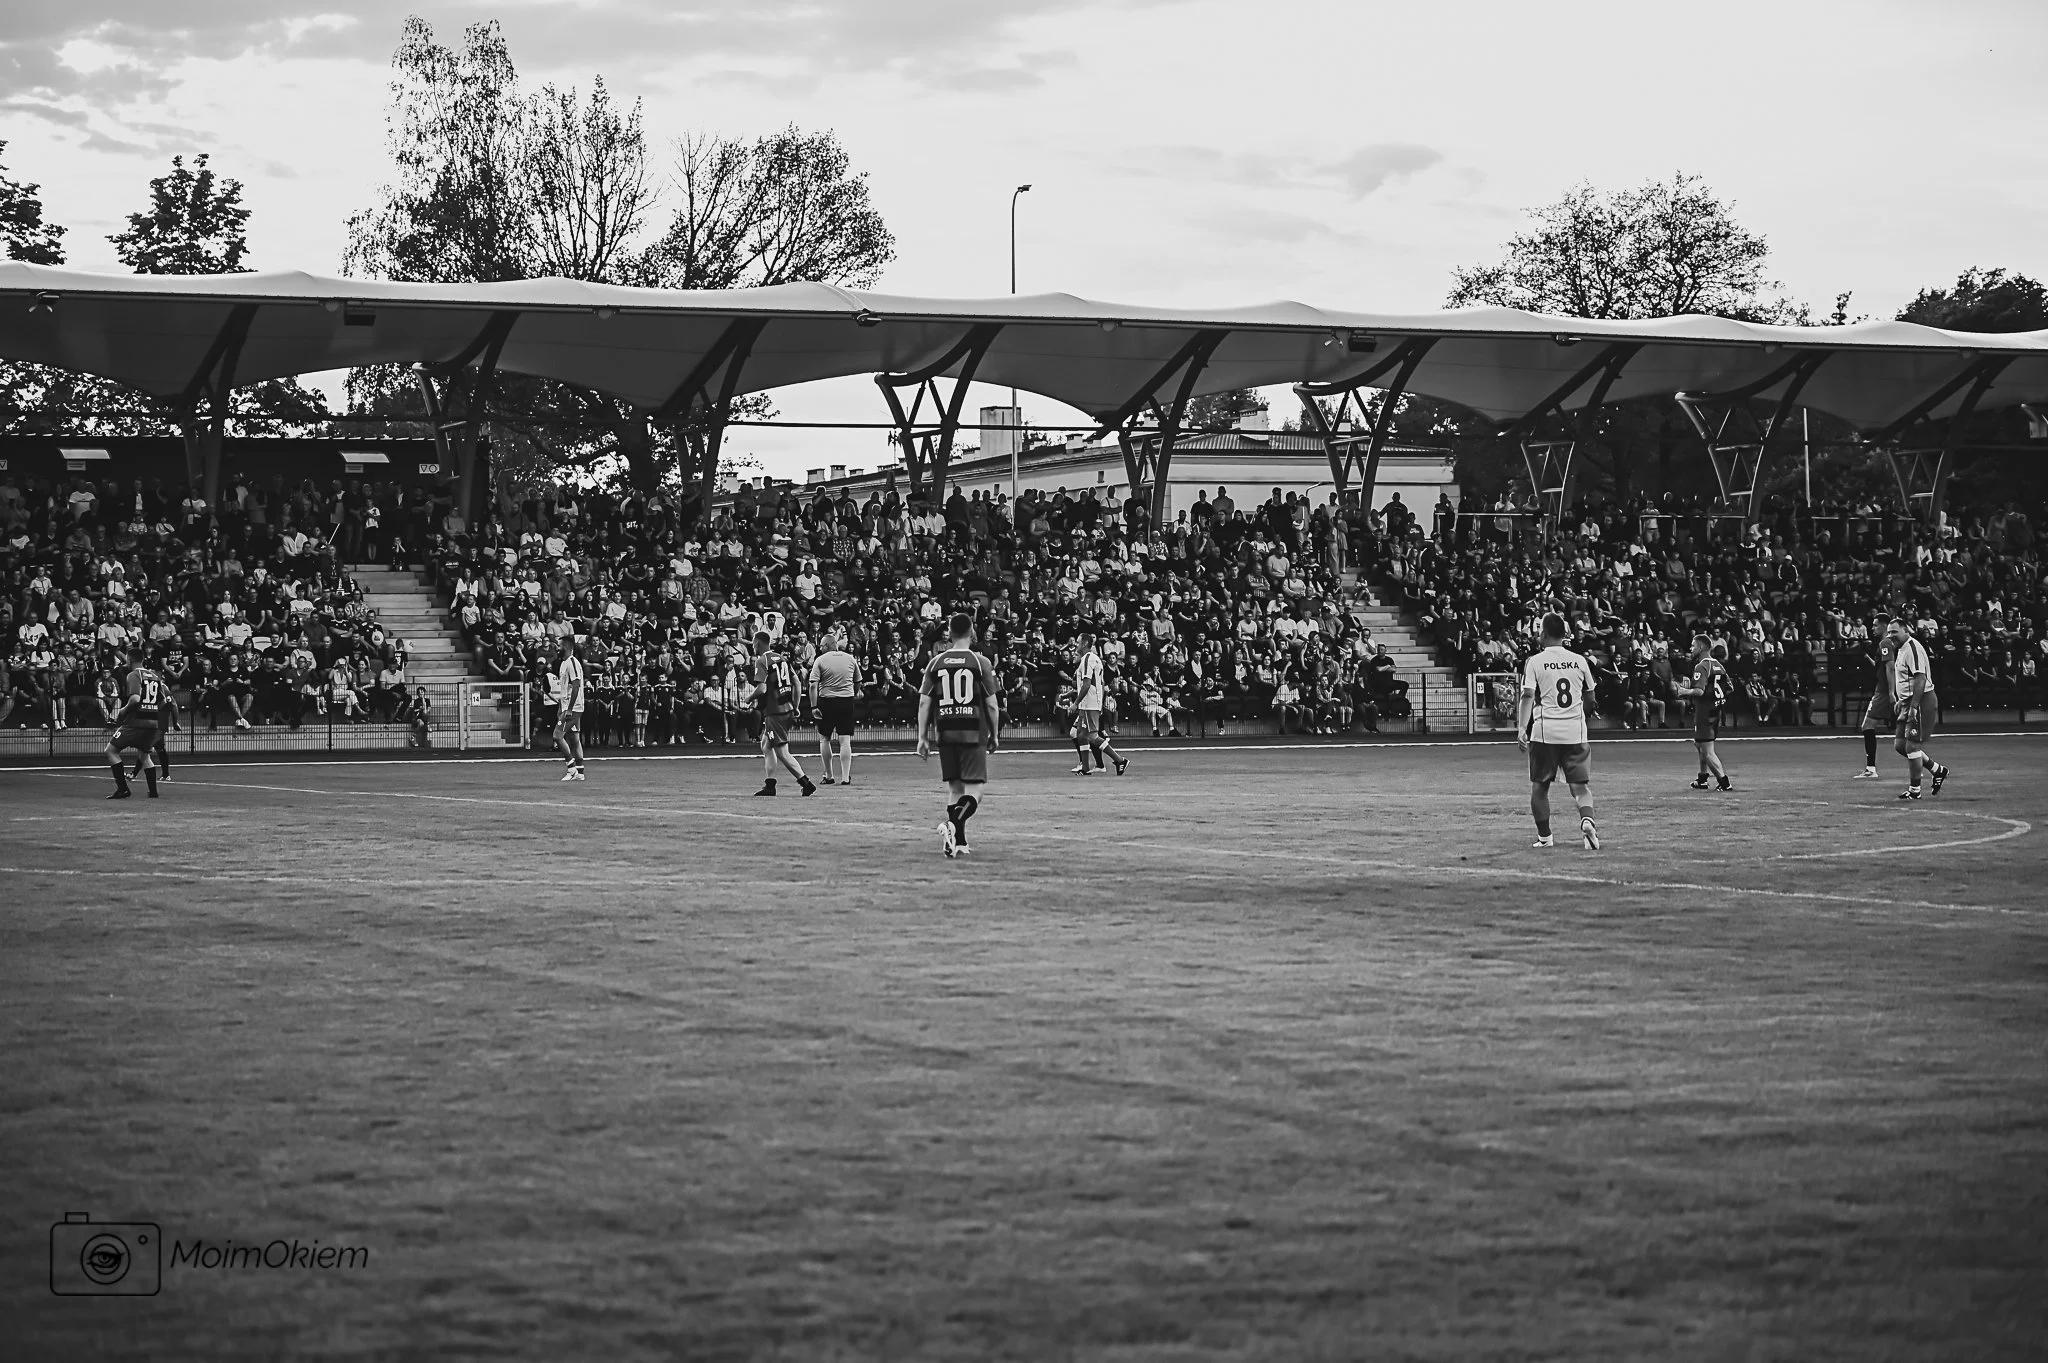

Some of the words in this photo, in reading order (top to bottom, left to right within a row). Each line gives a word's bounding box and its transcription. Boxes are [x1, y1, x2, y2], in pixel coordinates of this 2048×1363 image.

[772, 661, 791, 687] 14
[1544, 662, 1580, 670] POLSKA
[142, 680, 158, 703] 19
[938, 668, 974, 706] 10
[1556, 677, 1573, 708] 8
[1714, 675, 1724, 698] 5
[940, 708, 953, 716] SKS
[955, 706, 974, 715] STAR
